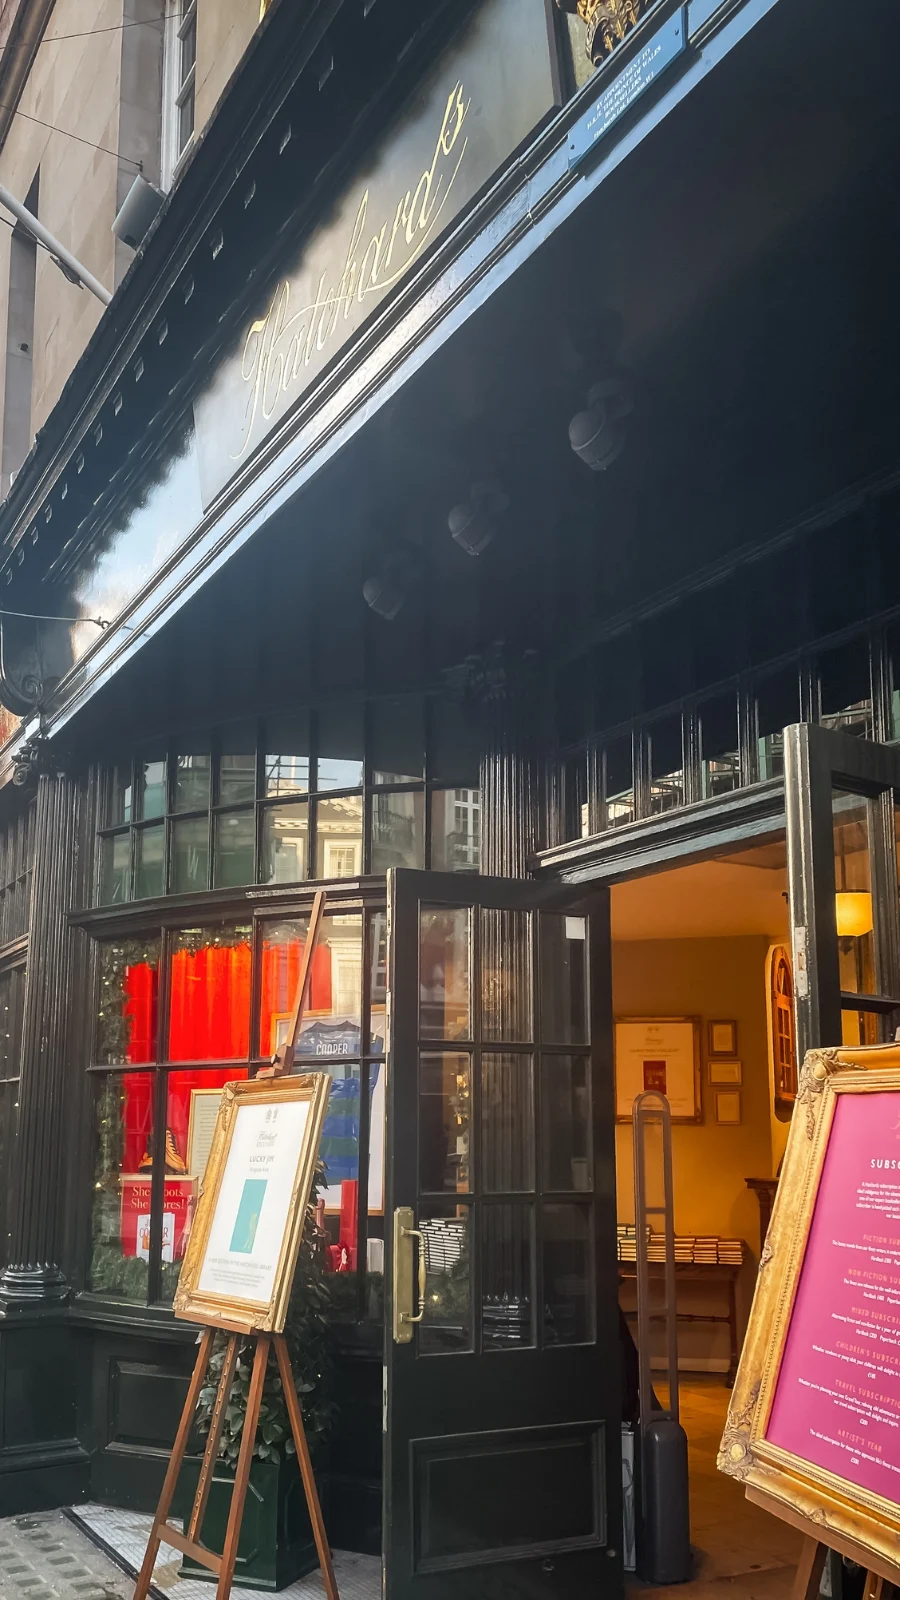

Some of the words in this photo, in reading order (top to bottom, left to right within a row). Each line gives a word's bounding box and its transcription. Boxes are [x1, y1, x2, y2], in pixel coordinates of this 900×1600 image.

[316, 1042, 348, 1055] COOPER
[132, 1186, 151, 1197] She
[131, 1198, 149, 1209] She
[863, 1234, 887, 1244] FICTION
[837, 1428, 865, 1446] ARTIST'S
[867, 1440, 882, 1453] YEAR
